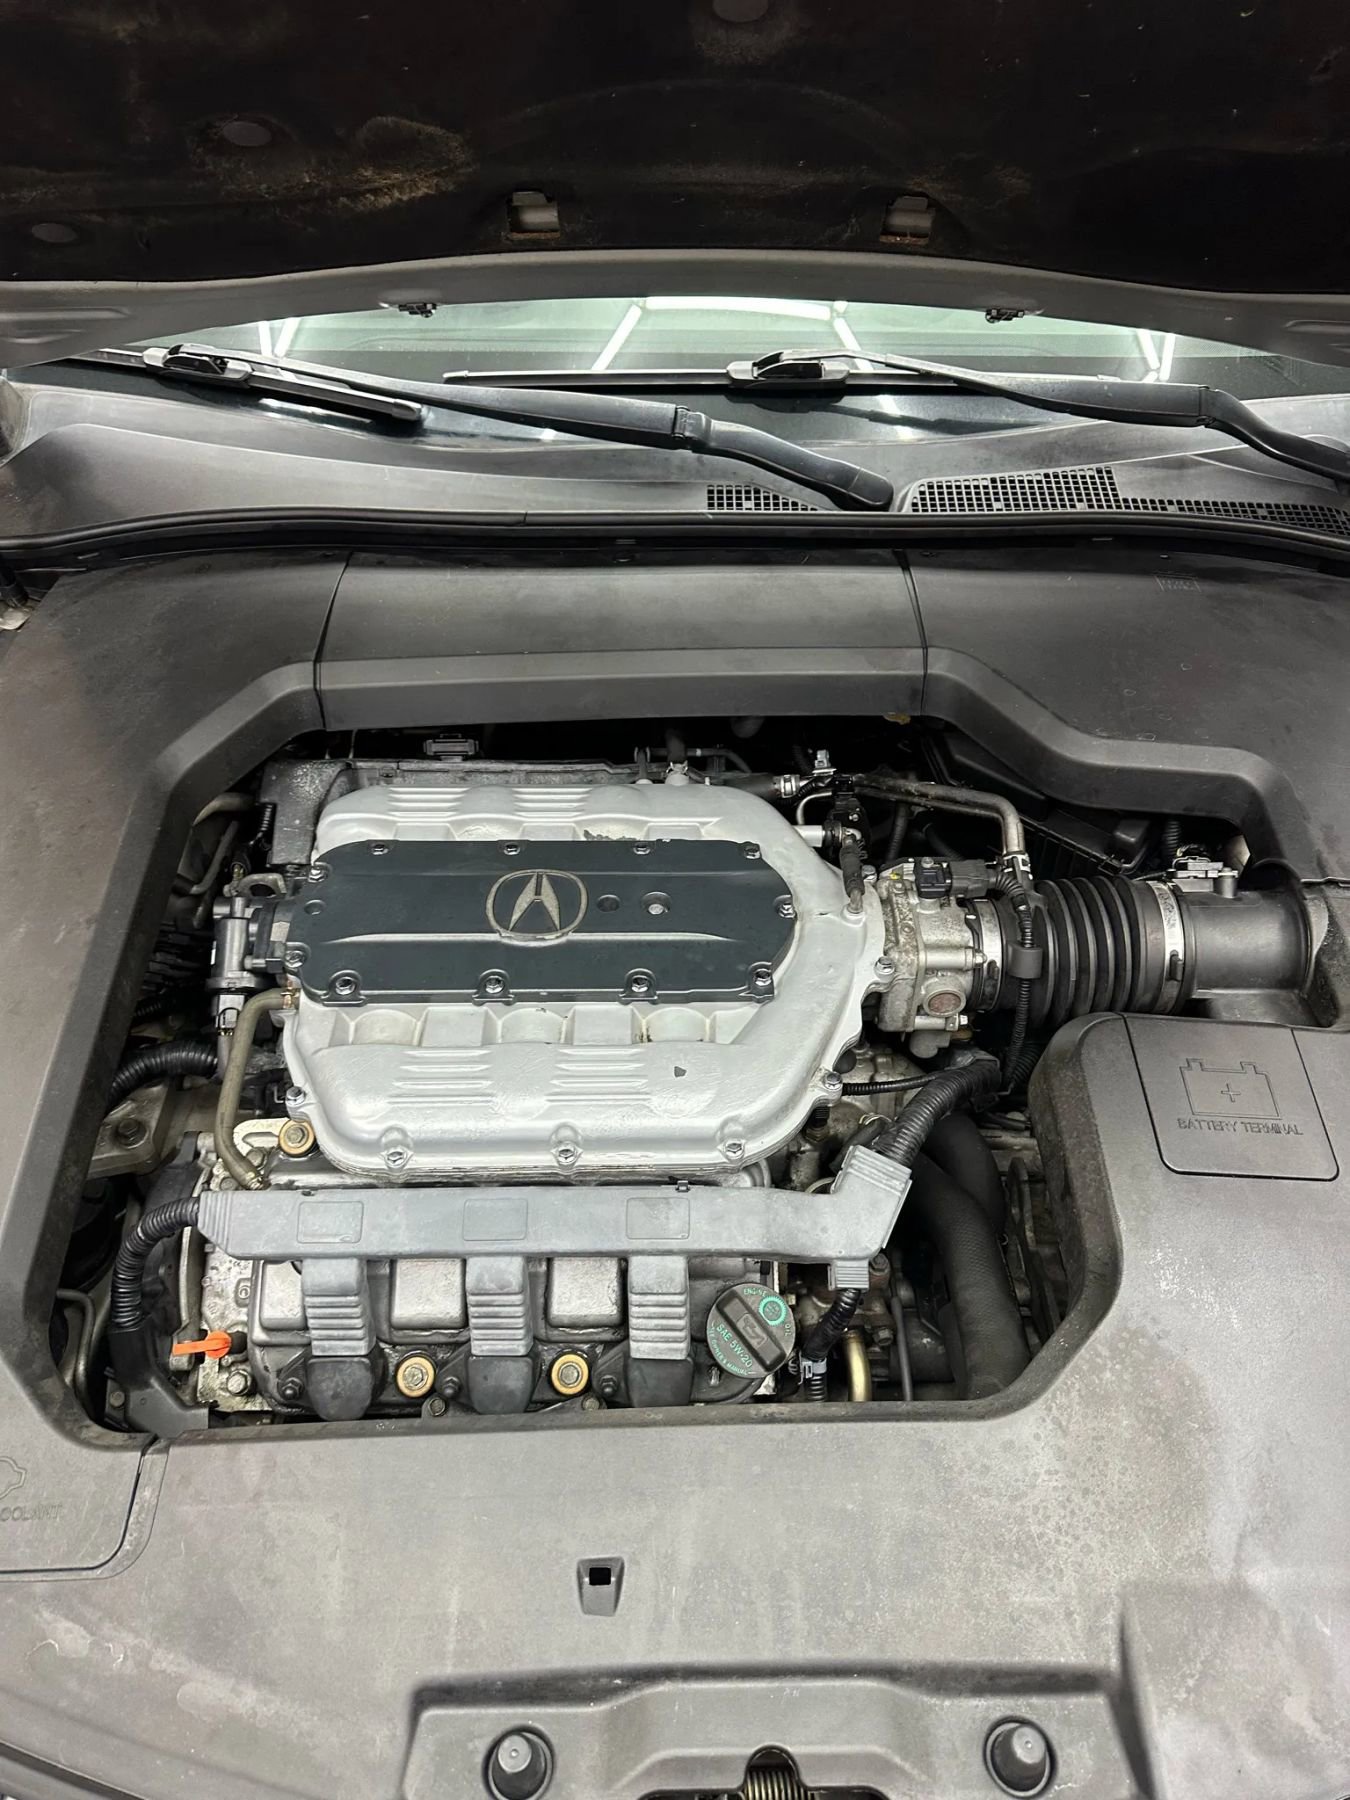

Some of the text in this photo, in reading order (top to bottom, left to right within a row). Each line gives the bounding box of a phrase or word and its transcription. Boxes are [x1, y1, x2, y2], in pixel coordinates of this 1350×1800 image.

[1177, 1117, 1305, 1136] BATTERY TERMINAL
[716, 1323, 733, 1342] SAE
